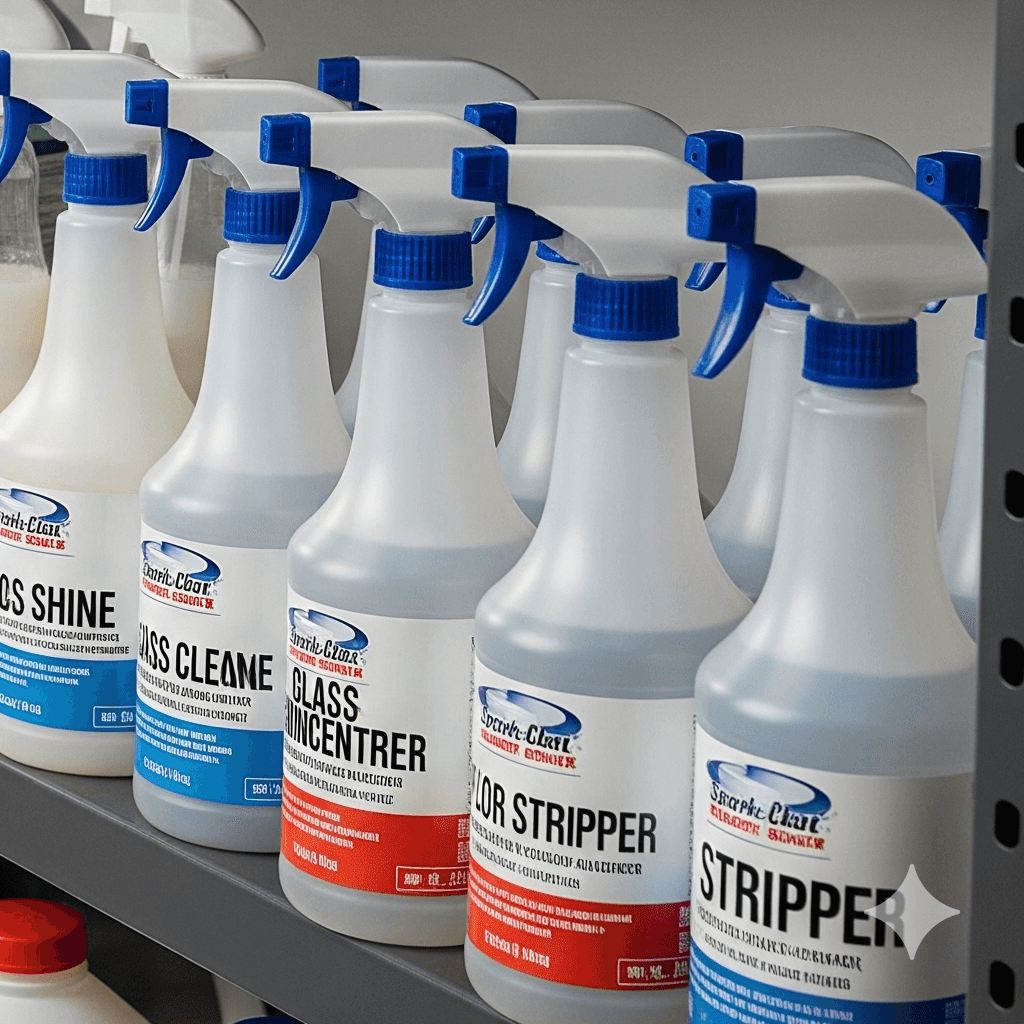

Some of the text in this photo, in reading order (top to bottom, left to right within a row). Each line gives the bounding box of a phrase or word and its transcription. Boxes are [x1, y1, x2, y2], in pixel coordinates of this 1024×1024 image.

[31, 583, 116, 629] SHINE
[292, 666, 361, 723] GLASS
[512, 792, 657, 854] STRIPPER
[700, 841, 906, 948] STRIPPER
